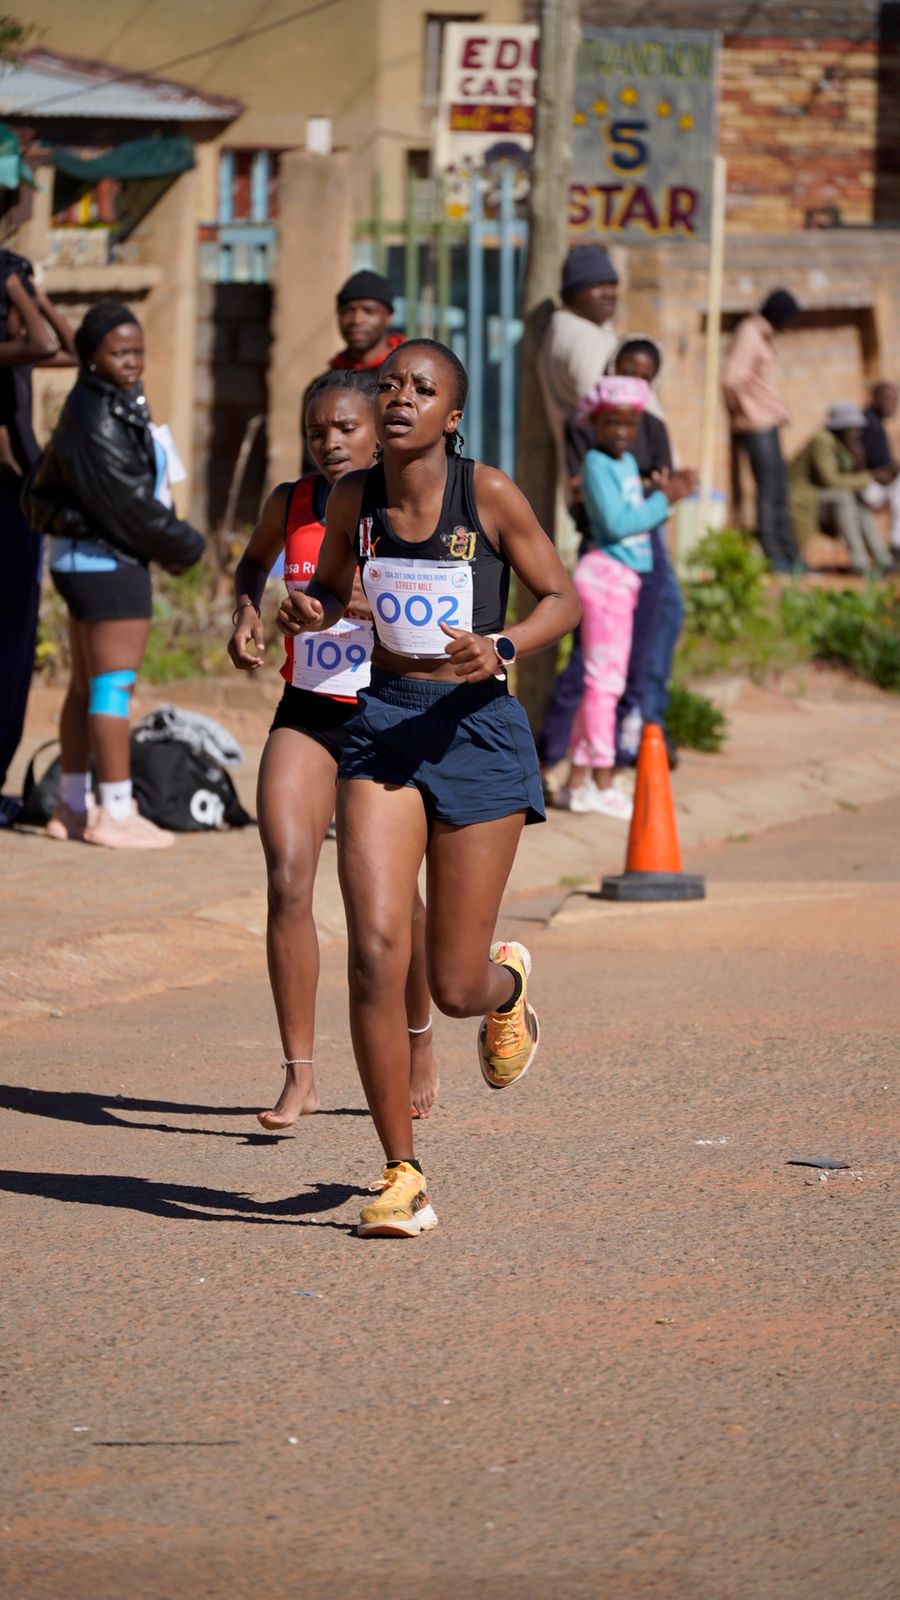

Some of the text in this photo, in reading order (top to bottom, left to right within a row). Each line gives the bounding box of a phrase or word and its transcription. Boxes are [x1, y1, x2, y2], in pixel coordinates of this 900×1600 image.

[460, 76, 537, 99] CAR
[605, 119, 648, 174] 5
[569, 183, 698, 234] STAR
[395, 581, 433, 591] STREET MILE
[377, 592, 459, 627] 002
[305, 638, 366, 673] 109
